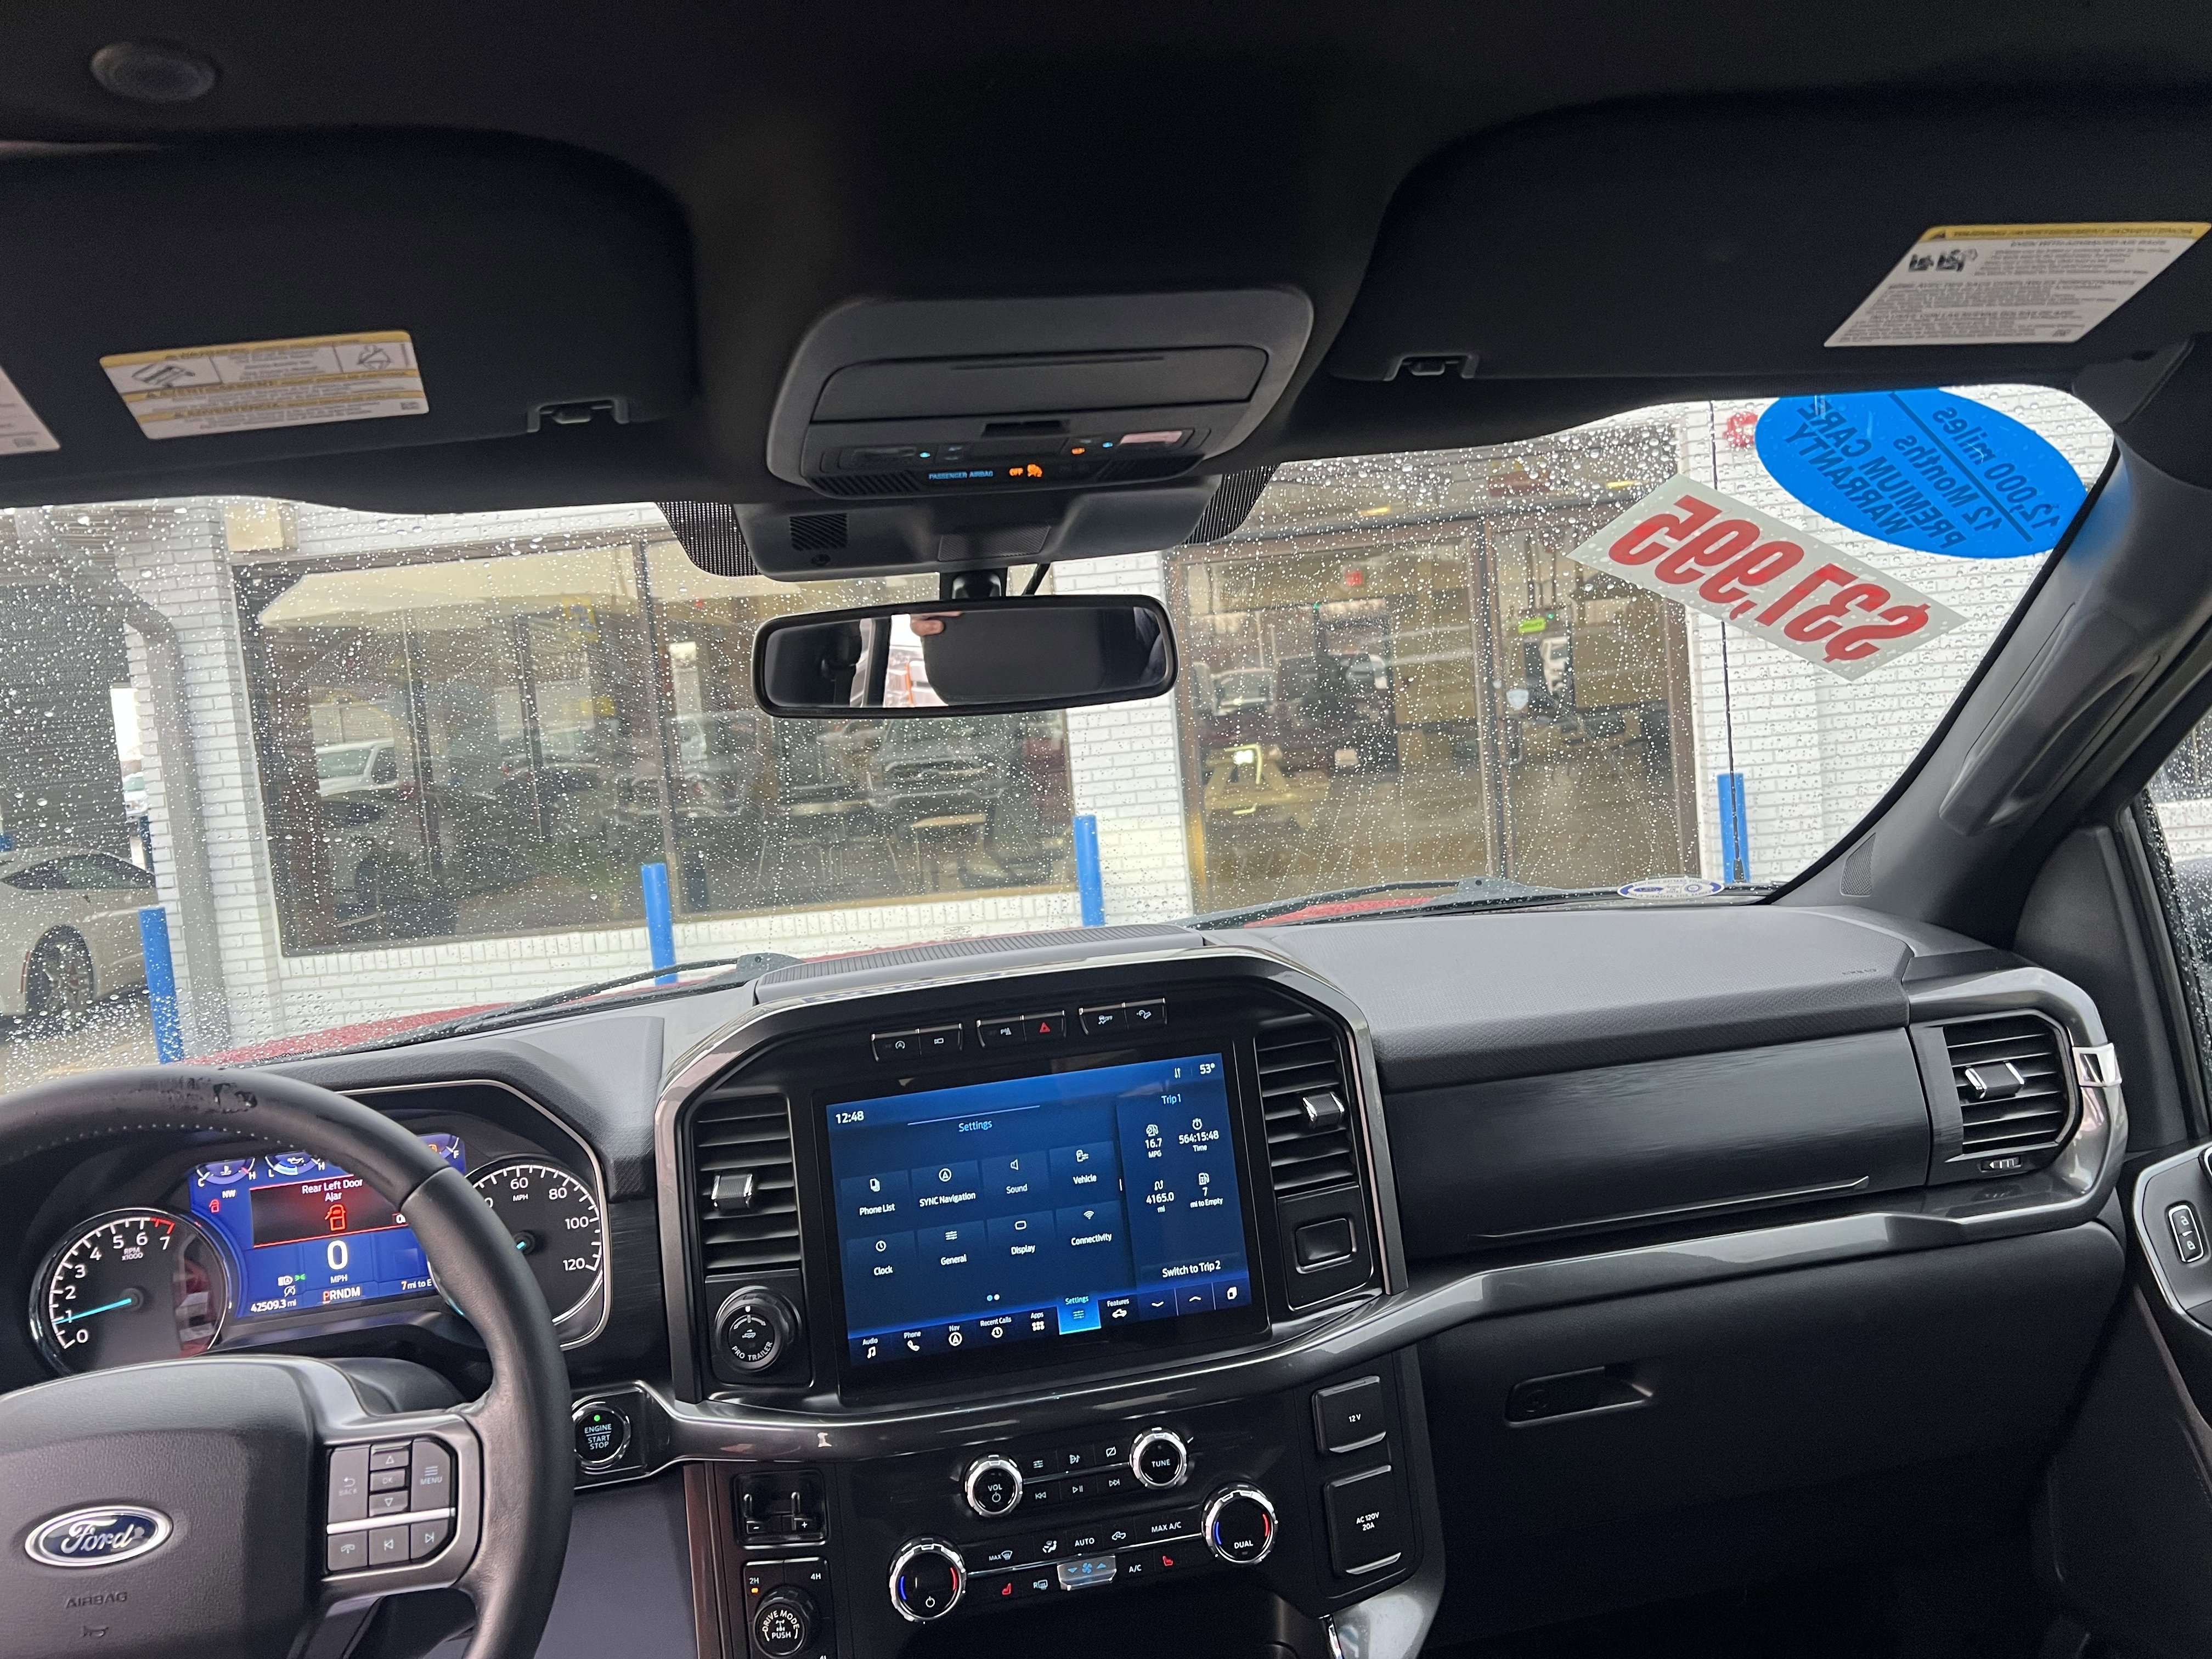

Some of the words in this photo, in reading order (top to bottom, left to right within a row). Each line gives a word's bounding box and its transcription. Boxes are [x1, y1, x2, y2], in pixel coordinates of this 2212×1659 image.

[929, 471, 967, 480] PASSENGER
[1009, 467, 1023, 476] OFF
[1161, 1094, 1177, 1105] Trip
[1177, 1093, 1181, 1103] 1
[836, 1110, 865, 1124] 12:48
[958, 1120, 992, 1132] Settings
[1178, 1130, 1220, 1144] 564:15:48
[1145, 1137, 1163, 1149] 16.7
[453, 1149, 460, 1159] F
[1148, 1150, 1163, 1158] MPG
[318, 1161, 325, 1171] H
[249, 1171, 256, 1180] H
[268, 1169, 275, 1178] L
[1073, 1173, 1097, 1184] Vehicle
[302, 1185, 321, 1194] Rear
[323, 1182, 341, 1191] Left
[343, 1179, 363, 1189] Door
[510, 1177, 529, 1190] 60
[1006, 1184, 1028, 1194] Sound
[222, 1189, 236, 1199] NW
[325, 1192, 342, 1203] Ajar
[512, 1193, 529, 1202] MPH
[549, 1187, 568, 1200] 80
[1202, 1187, 1209, 1197] 7
[919, 1197, 939, 1207] SYNC
[939, 1192, 977, 1204] Navigation
[1146, 1192, 1175, 1204] 4165.0
[1205, 1197, 1223, 1206] Empty
[859, 1205, 882, 1216] Phone
[883, 1203, 895, 1213] List
[1156, 1205, 1166, 1213] mi
[565, 1216, 589, 1230] 100
[112, 1235, 125, 1249] 5
[136, 1232, 149, 1246] 6
[159, 1236, 171, 1250] 7
[1071, 1233, 1112, 1246] Connectivity
[89, 1247, 102, 1261] 4
[123, 1246, 140, 1255] RPM
[327, 1240, 348, 1270] 0
[1011, 1244, 1036, 1255] Display
[122, 1252, 144, 1261] x1000
[940, 1254, 967, 1266] General
[563, 1257, 586, 1271] 120
[1162, 1265, 1189, 1278] Switch
[1189, 1264, 1199, 1274] to
[1199, 1261, 1215, 1272] Trip
[1215, 1260, 1221, 1270] 2
[75, 1265, 87, 1278] 3
[873, 1265, 894, 1276] Clock
[330, 1274, 348, 1284] MPH
[401, 1280, 408, 1290] 7
[408, 1280, 417, 1290] mi
[417, 1279, 426, 1288] to
[65, 1286, 76, 1300] 2
[323, 1286, 361, 1301] PRNDM
[251, 1299, 287, 1313] 42509.3
[287, 1299, 297, 1308] mi
[1065, 1296, 1089, 1305] Settings
[1106, 1298, 1130, 1307] Features
[65, 1310, 72, 1324] 1
[980, 1318, 998, 1327] Recent
[998, 1316, 1012, 1324] Calls
[76, 1329, 89, 1344] 0
[904, 1331, 921, 1339] Phone
[862, 1338, 878, 1346] Audio
[731, 1345, 746, 1359] PRO
[747, 1341, 773, 1361] TRAILER
[584, 1423, 612, 1434] ENGINE
[588, 1434, 611, 1444] START
[590, 1441, 609, 1450] STOP
[1151, 1458, 1171, 1468] TUNE
[420, 1476, 443, 1486] MENU
[338, 1488, 357, 1497] BACK
[988, 1483, 1003, 1492] VOL
[1356, 1516, 1365, 1525] AC
[1365, 1511, 1380, 1521] 120V
[1151, 1524, 1168, 1533] MAX
[1169, 1521, 1182, 1531] A/C
[1362, 1522, 1375, 1531] 20A
[60, 1519, 134, 1554] Ford
[1074, 1537, 1095, 1548] AUTO
[1234, 1539, 1254, 1549] DUAL
[1128, 1564, 1142, 1573] A/C
[65, 1592, 128, 1609] AIRBAG
[761, 1610, 778, 1633] DRIVE
[780, 1609, 800, 1630] MODE
[771, 1631, 792, 1639] PUSH
